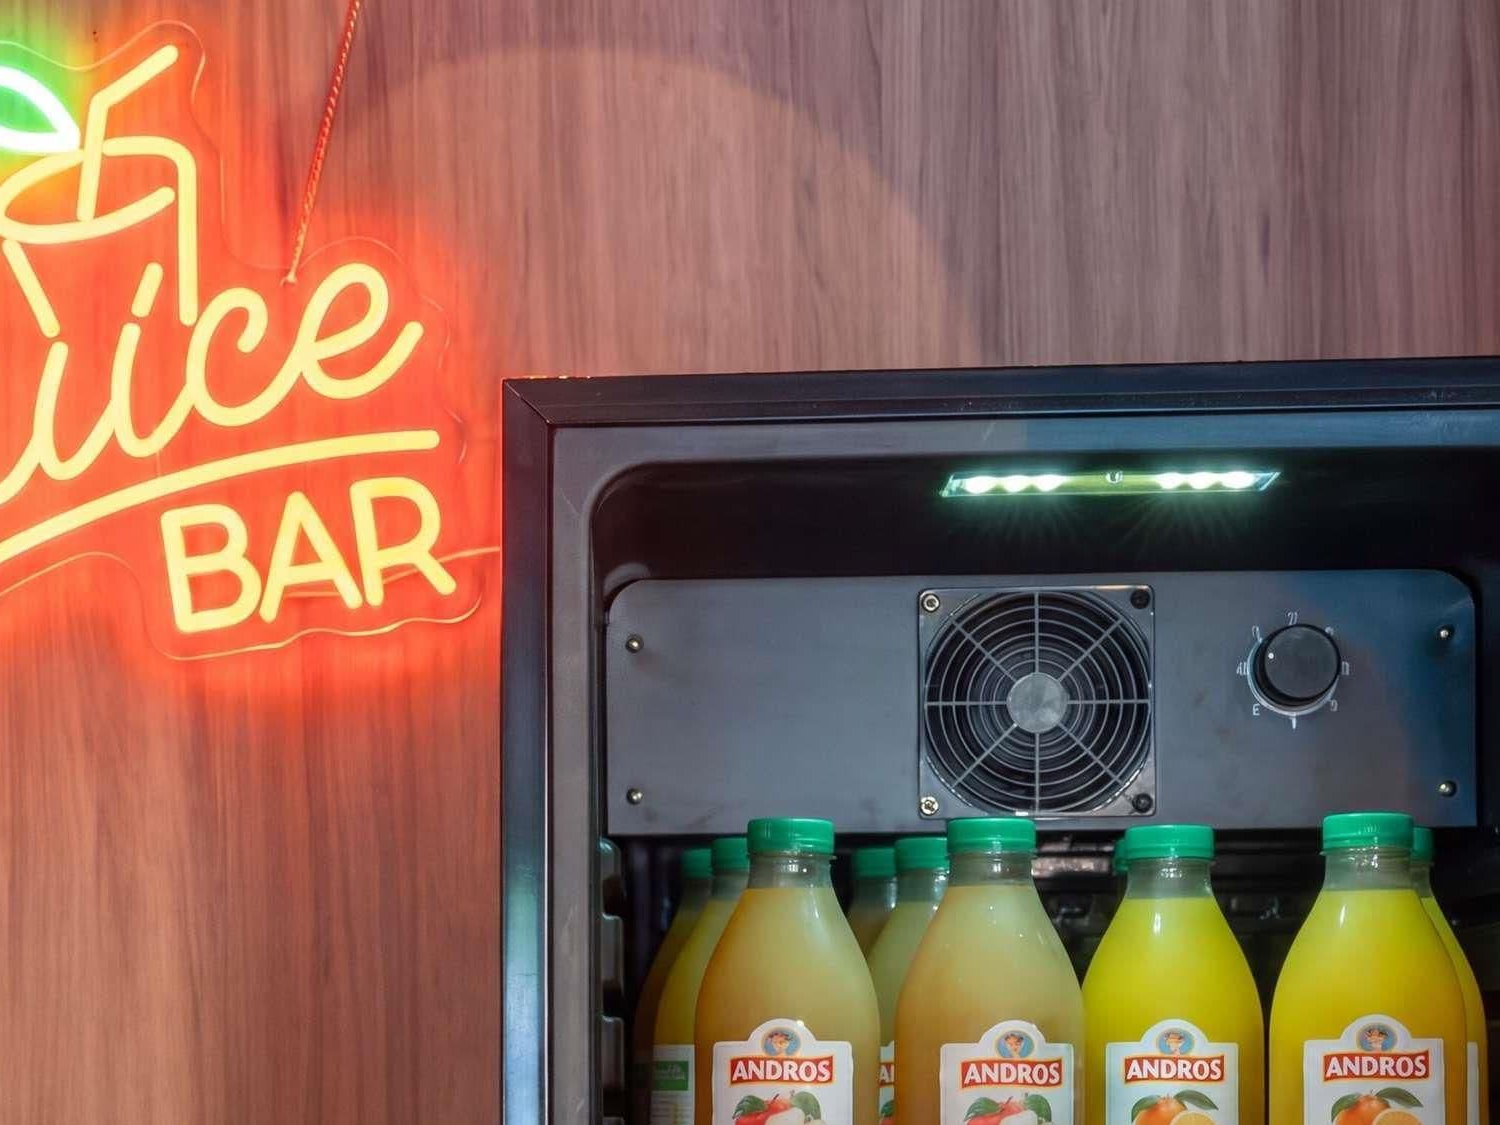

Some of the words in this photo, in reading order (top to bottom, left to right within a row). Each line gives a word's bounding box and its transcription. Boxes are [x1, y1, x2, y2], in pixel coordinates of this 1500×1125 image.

[160, 477, 456, 633] BAR
[732, 1059, 832, 1083] ANDROS
[963, 1059, 1060, 1086] ANDROS
[1126, 1058, 1222, 1081] ANDROS
[1325, 1055, 1428, 1077] ANDROS
